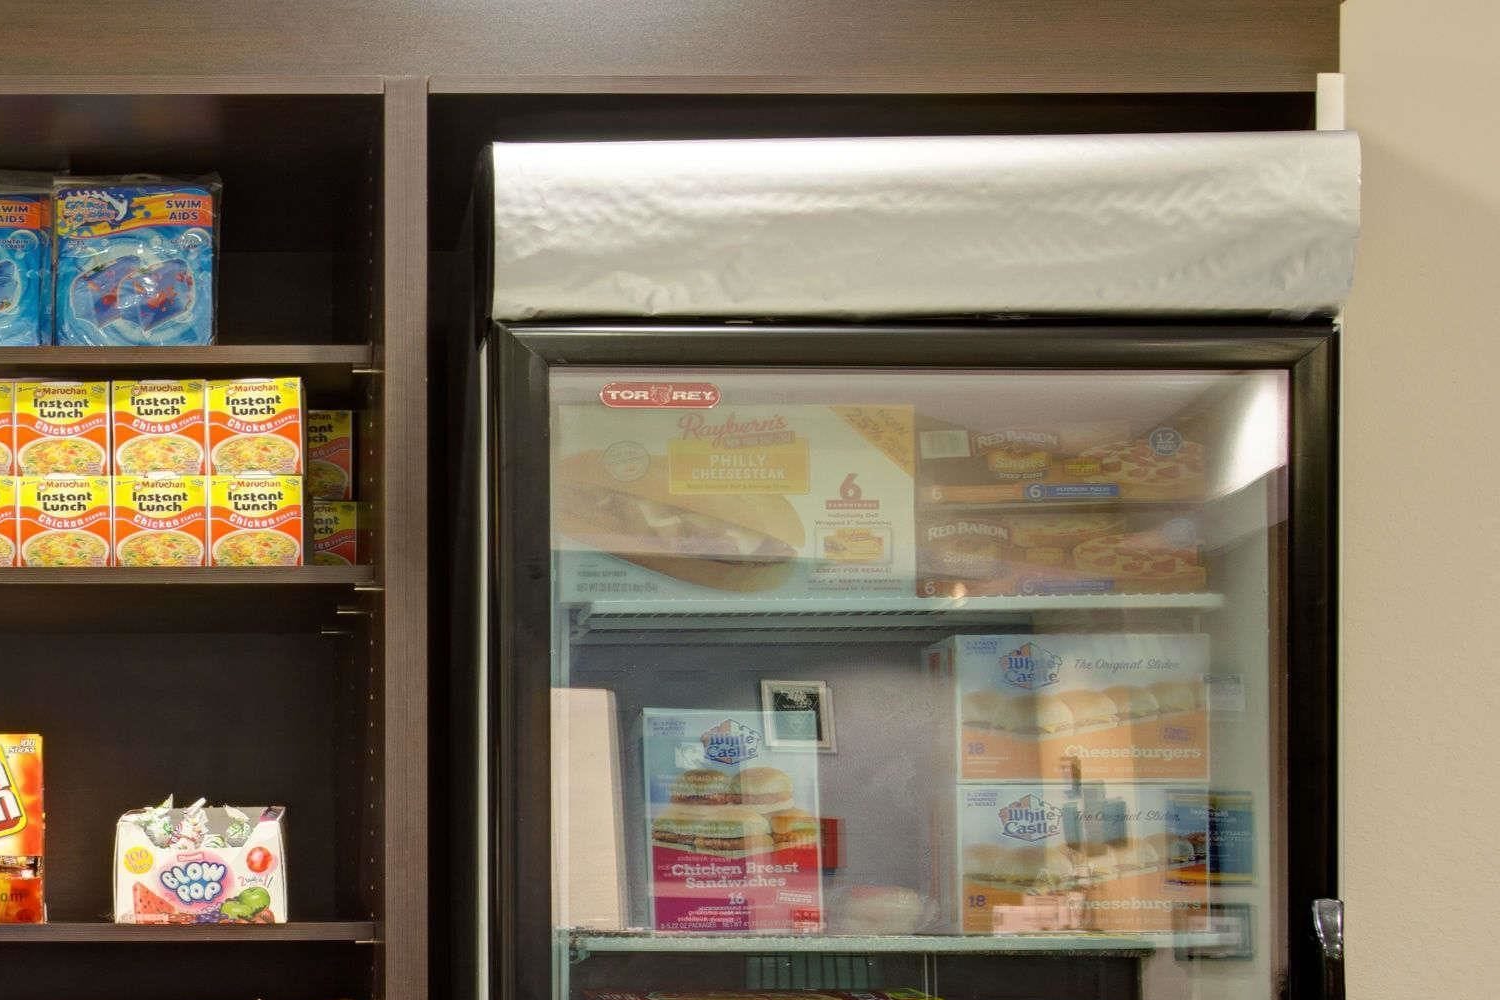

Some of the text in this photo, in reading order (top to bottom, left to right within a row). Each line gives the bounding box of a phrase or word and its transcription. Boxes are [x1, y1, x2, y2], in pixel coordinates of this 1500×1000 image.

[166, 200, 202, 208] SWIM
[169, 211, 199, 220] AIDS
[43, 387, 87, 395] Maruchan
[140, 384, 184, 392] Maruchan
[131, 396, 186, 406] Instant
[226, 396, 281, 406] Instant
[607, 390, 712, 400] TOR REY
[34, 399, 89, 408] Instant
[232, 405, 276, 415] Lunch
[39, 409, 83, 418] Lunch
[137, 406, 181, 416] Lunch
[35, 420, 80, 436] Chicken
[132, 418, 178, 433] Chicken
[228, 418, 273, 433] Chicken
[977, 430, 1059, 447] RED BARON
[710, 455, 767, 467] PHILLY
[691, 467, 786, 480] CHEESESTEAK
[839, 472, 862, 501] 6
[928, 522, 1009, 540] RED BARON
[1064, 745, 1201, 760] Cheeseburgers
[1008, 810, 1056, 823] White
[1004, 822, 1058, 835] Castle
[161, 862, 226, 889] BLOW
[671, 862, 800, 877] Chicken Breast
[685, 876, 787, 889] Sandwiches
[177, 881, 222, 903] POP
[728, 893, 745, 905] 16
